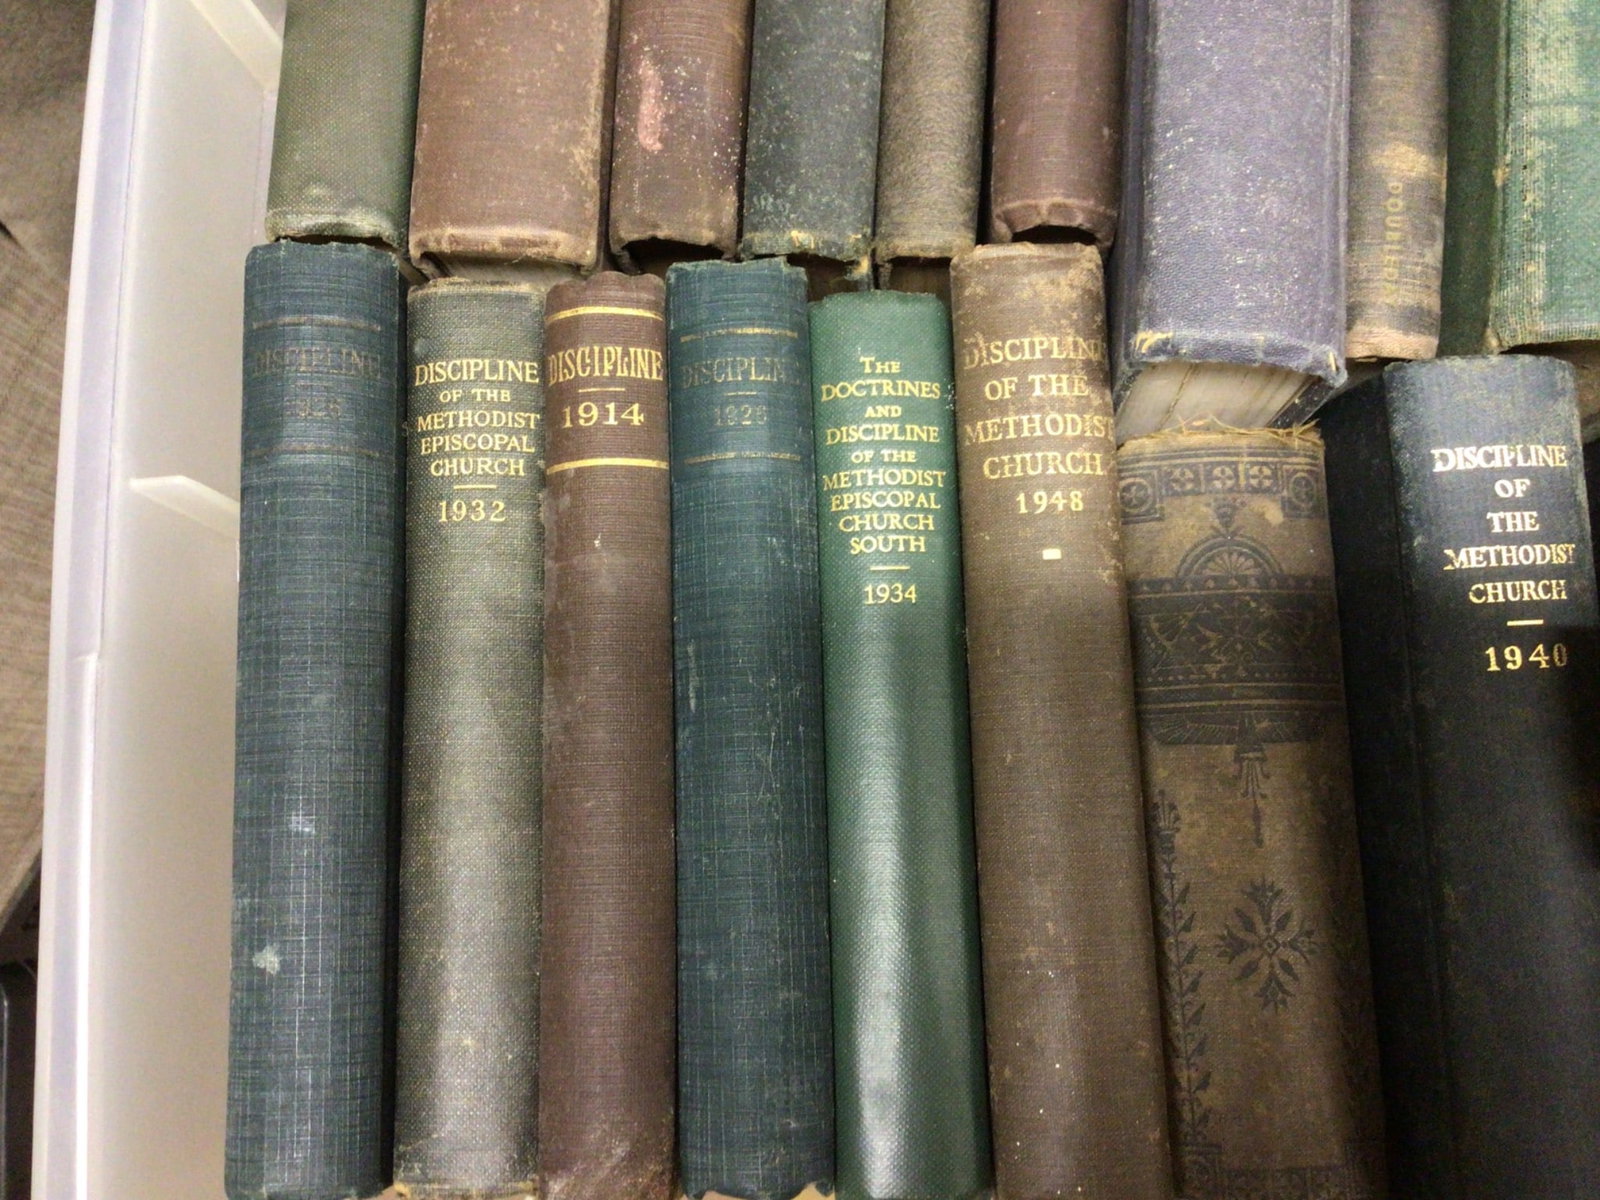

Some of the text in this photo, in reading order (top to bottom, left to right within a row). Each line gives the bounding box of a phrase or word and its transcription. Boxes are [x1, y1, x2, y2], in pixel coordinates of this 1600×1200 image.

[963, 334, 1106, 371] DISCIPLINE
[414, 360, 540, 387] DISCIPLINE
[547, 346, 664, 385] DISCIPLINE
[440, 388, 511, 403] OF THE
[820, 379, 941, 401] DOCTRINES
[984, 373, 1091, 401] OF THE
[561, 402, 645, 428] 1914
[865, 404, 902, 418] AND
[417, 413, 540, 433] METHODIST
[964, 413, 1115, 446] METHODIST
[420, 434, 536, 455] EPISCOPAL
[825, 425, 941, 446] DISCIPLINE
[850, 448, 917, 463] OF THE
[982, 451, 1108, 480] CHURCH
[1431, 443, 1568, 473] DISCIPLINE
[430, 458, 525, 477] CHURCH
[823, 469, 946, 493] METHODIST
[1493, 478, 1531, 498] OF
[438, 499, 507, 523] 1932
[830, 492, 941, 512] EPISCOPAL
[1015, 489, 1085, 515] 1948
[838, 514, 935, 533] CHURCH
[1487, 510, 1540, 533] THE
[849, 535, 926, 555] SOUTH
[1443, 543, 1576, 572] METHODIST
[863, 583, 918, 605] 1934
[1468, 578, 1568, 605] CHURCH
[1485, 643, 1568, 673] 1940
